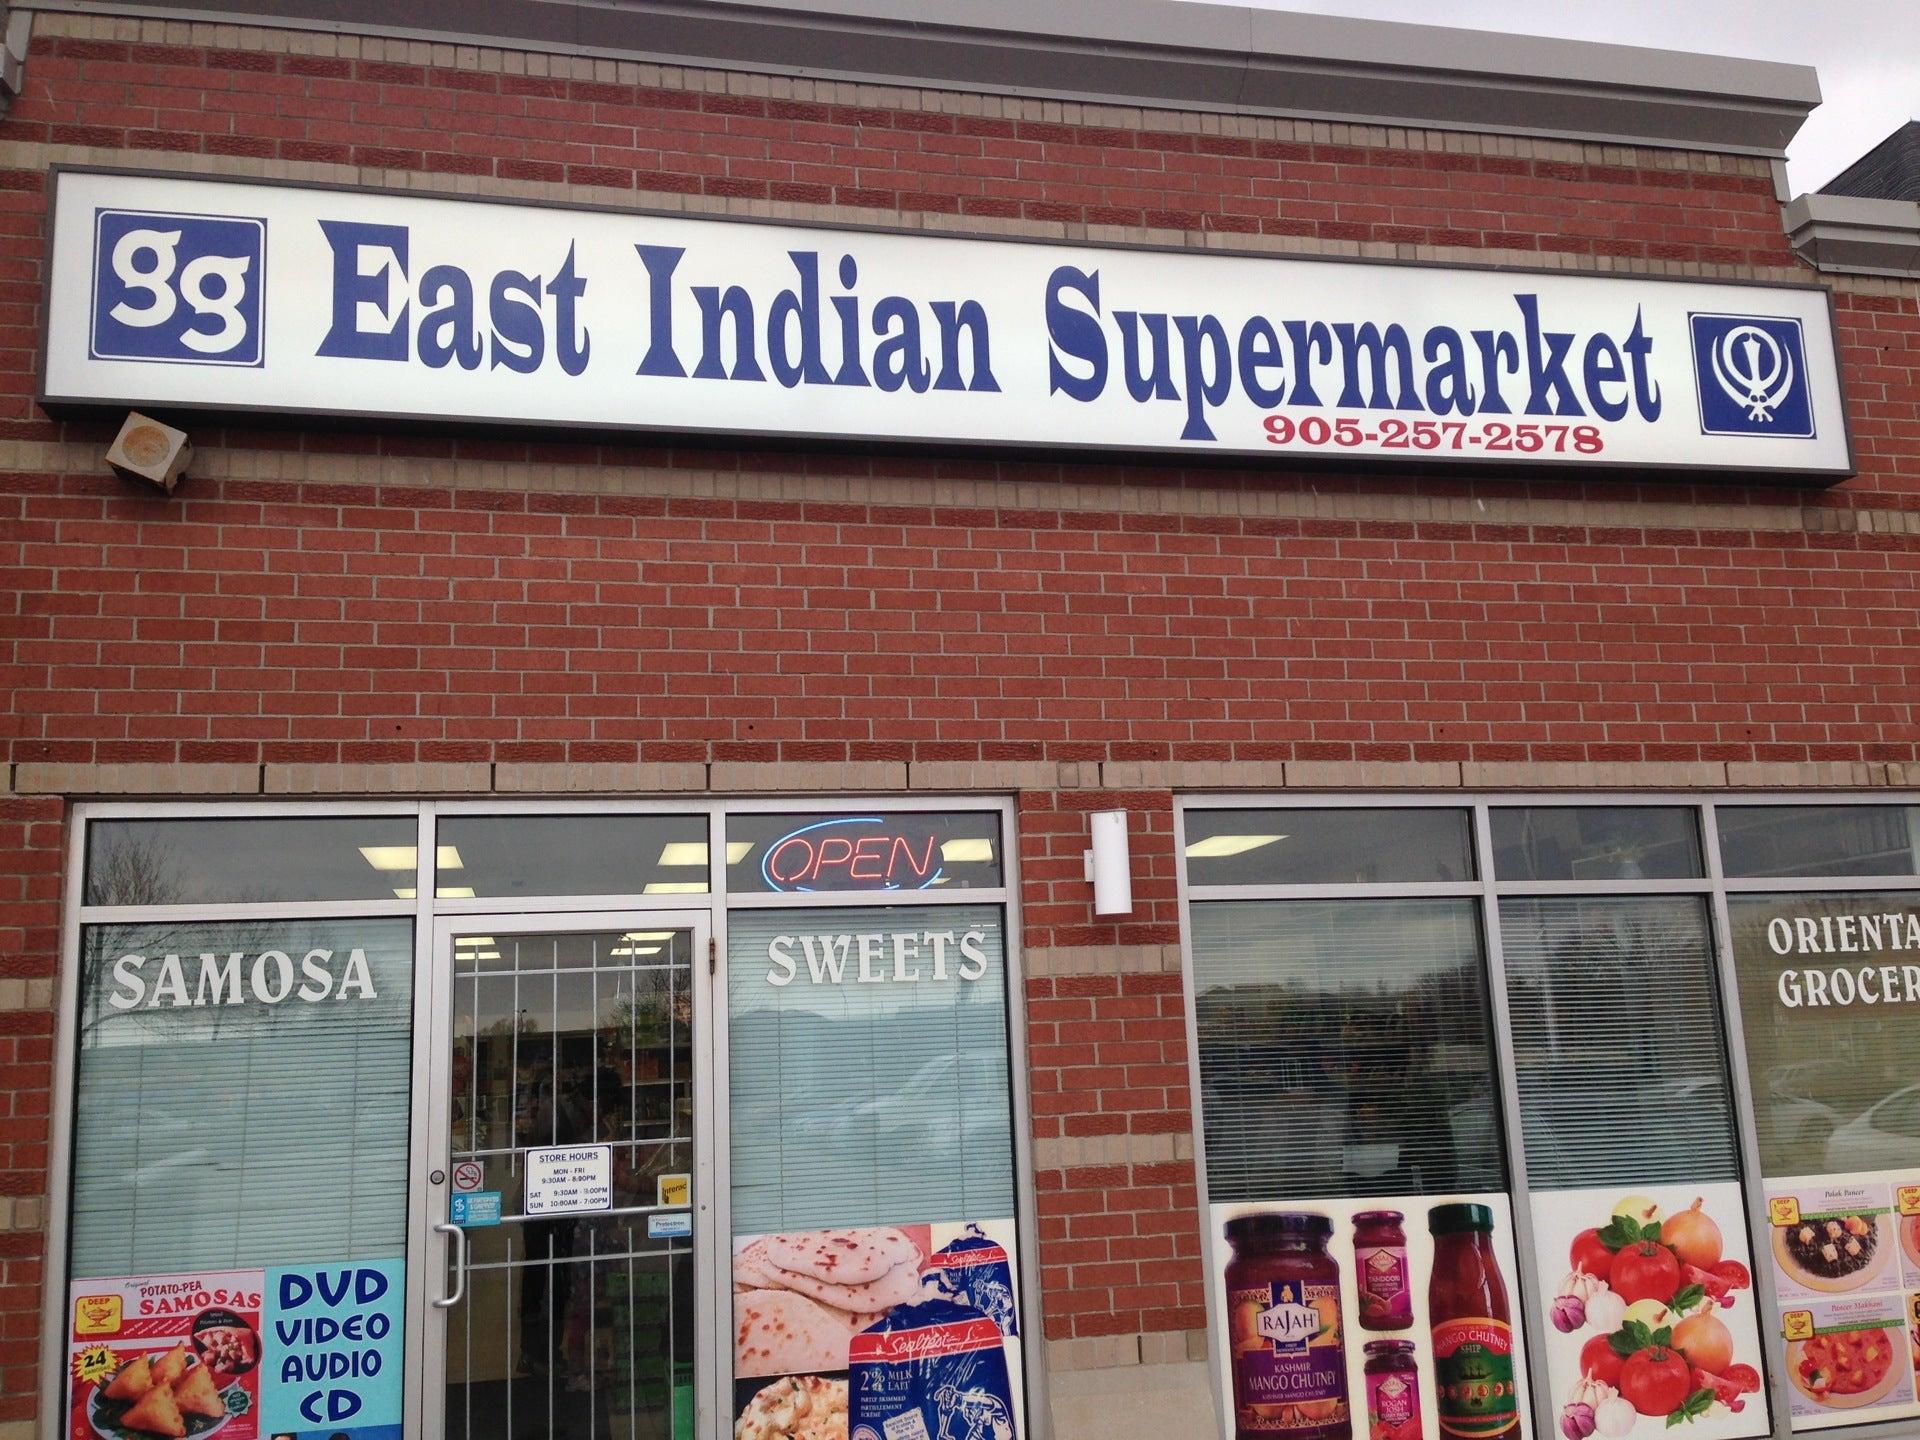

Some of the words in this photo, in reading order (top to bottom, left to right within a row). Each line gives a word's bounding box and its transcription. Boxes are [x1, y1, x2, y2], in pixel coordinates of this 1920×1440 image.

[315, 219, 591, 376] East
[634, 243, 1002, 393] Indian
[1045, 265, 1661, 441] Supermarket
[1263, 415, 1603, 454] 905-257-2578
[771, 836, 934, 880] OPEN
[766, 930, 988, 986] SWEETS
[109, 948, 377, 1009] SAMOSA
[1778, 966, 1920, 1008] GROCER
[540, 1153, 567, 1163] STORE
[569, 1152, 599, 1161] HOURS
[542, 1176, 566, 1184] 9:30AM
[662, 1184, 687, 1194] Interac
[554, 1189, 578, 1197] 9:30AM
[584, 1197, 608, 1205] 7:00PM
[140, 1281, 202, 1297] POTATO-PEA
[279, 1268, 388, 1311] DVD
[140, 1289, 261, 1316] SAMOSAS
[275, 1312, 391, 1347] VIDEO
[1263, 1310, 1314, 1335] RAJAH
[1461, 1344, 1482, 1353] SHIP
[1468, 1330, 1508, 1351] CHUTNEY
[84, 1350, 106, 1368] 24
[281, 1348, 382, 1384] AUDIO
[1274, 1362, 1311, 1374] KASHMIR
[888, 1370, 913, 1382] MILK
[1249, 1374, 1288, 1391] MANGO
[1291, 1371, 1336, 1389] CHUTNEY
[299, 1389, 362, 1424] CD
